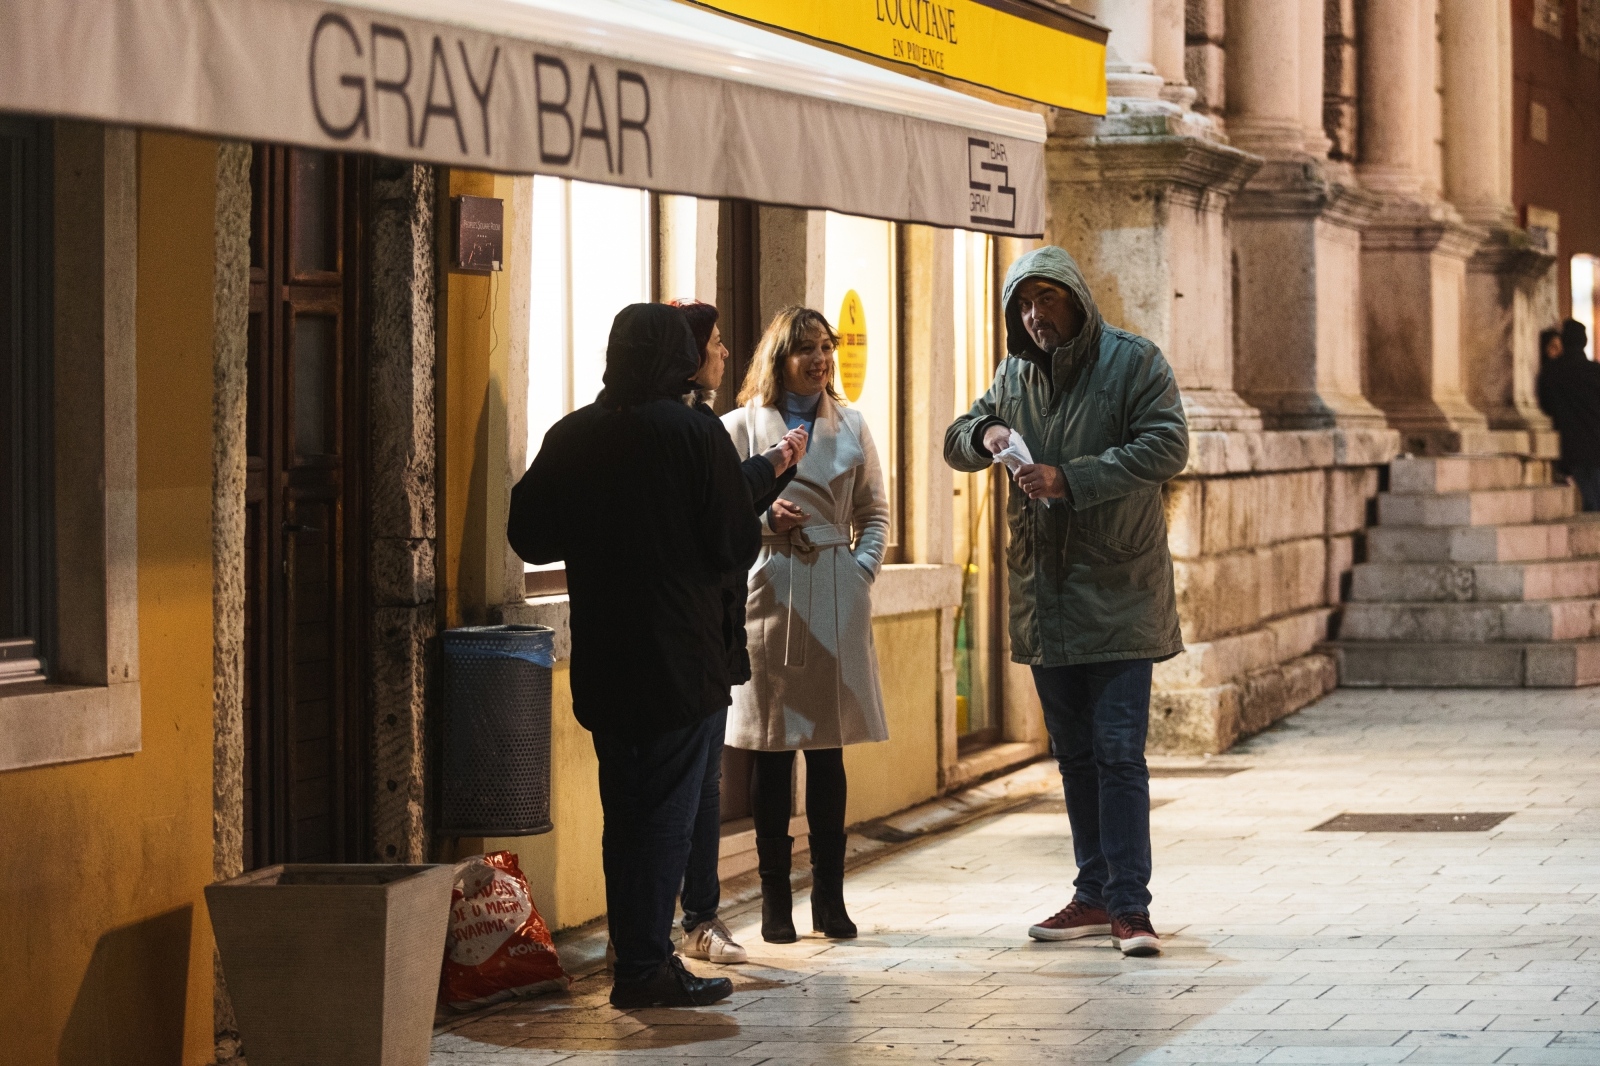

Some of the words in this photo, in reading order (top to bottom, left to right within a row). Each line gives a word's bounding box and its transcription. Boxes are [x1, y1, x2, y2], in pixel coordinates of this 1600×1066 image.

[875, 0, 958, 44] LOCCITANE
[892, 38, 904, 58] EN
[906, 41, 944, 70] PVENCE
[308, 12, 500, 156] GRAY
[533, 53, 653, 178] BAR
[990, 141, 1008, 162] BAR
[969, 192, 990, 213] GRAY
[471, 879, 517, 900] DOST
[471, 903, 482, 918] U
